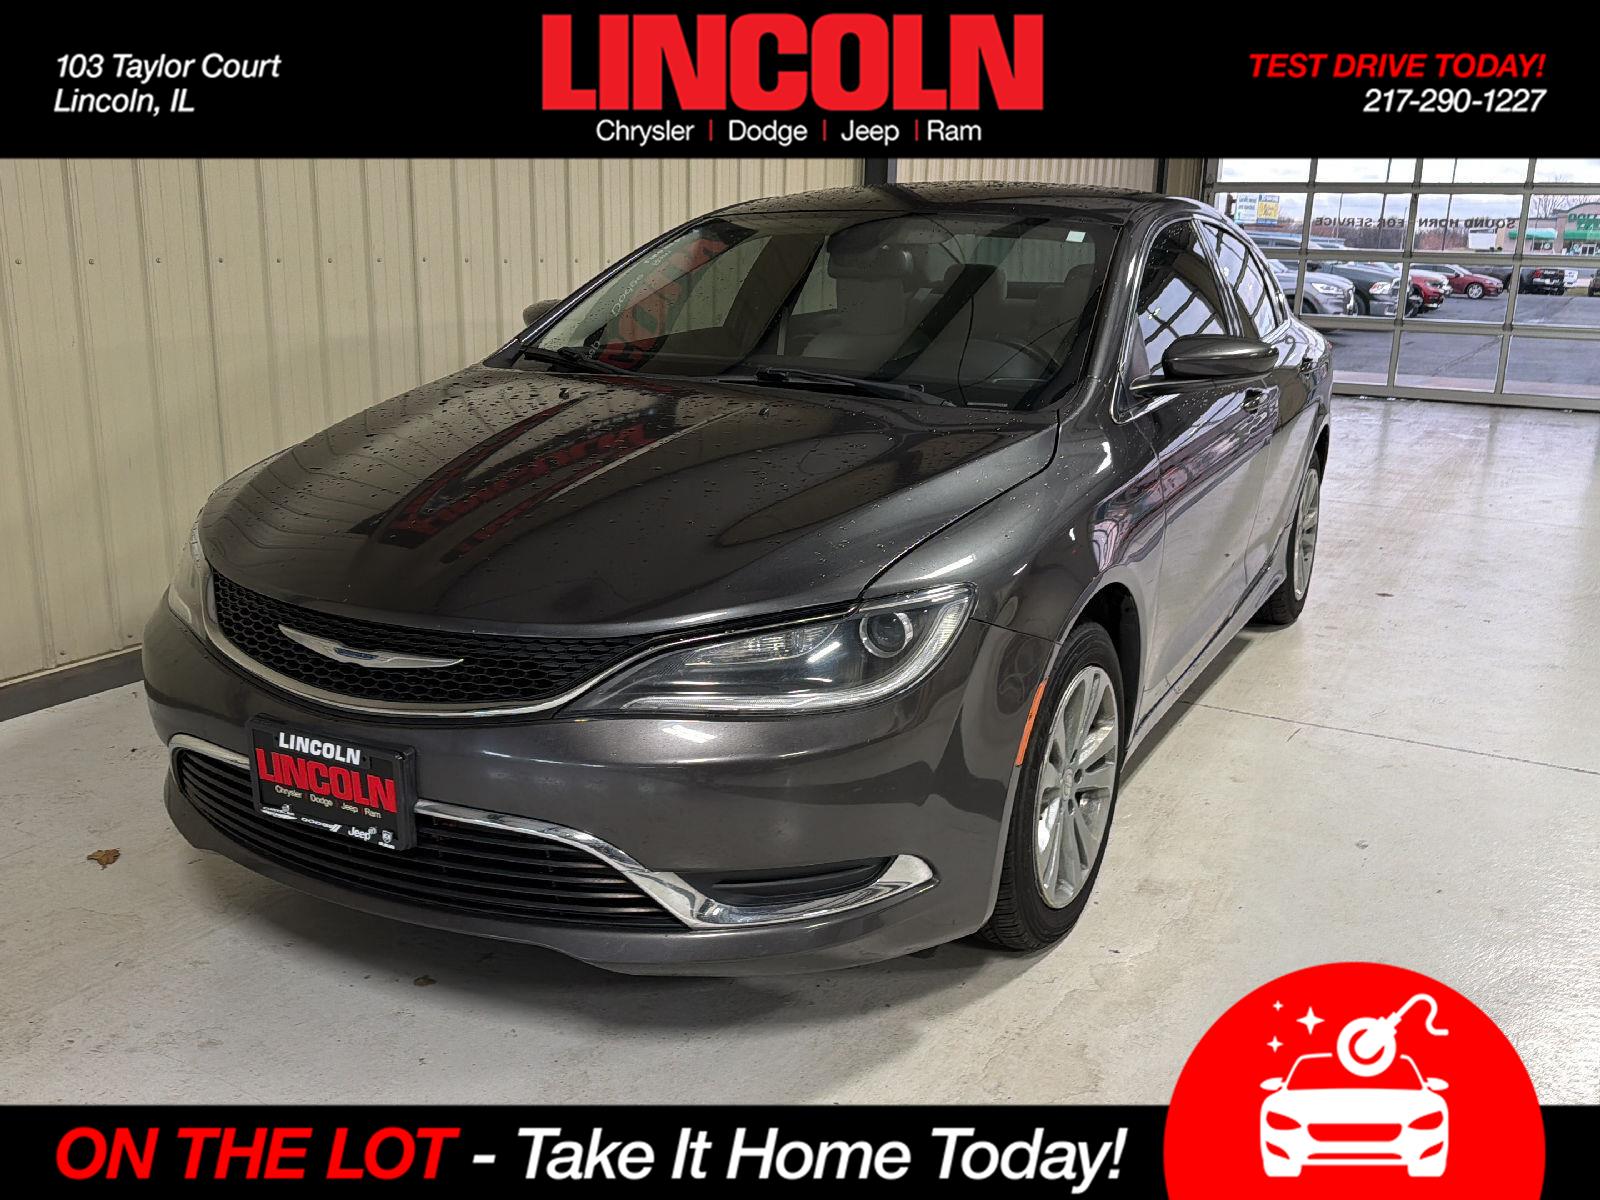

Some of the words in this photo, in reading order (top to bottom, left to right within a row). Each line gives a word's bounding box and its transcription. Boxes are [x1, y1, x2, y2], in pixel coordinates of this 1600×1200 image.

[278, 732, 361, 765] LINCOLN
[256, 748, 397, 813] LINCOLN
[309, 793, 334, 807] Dodge
[347, 826, 371, 842] Jeep
